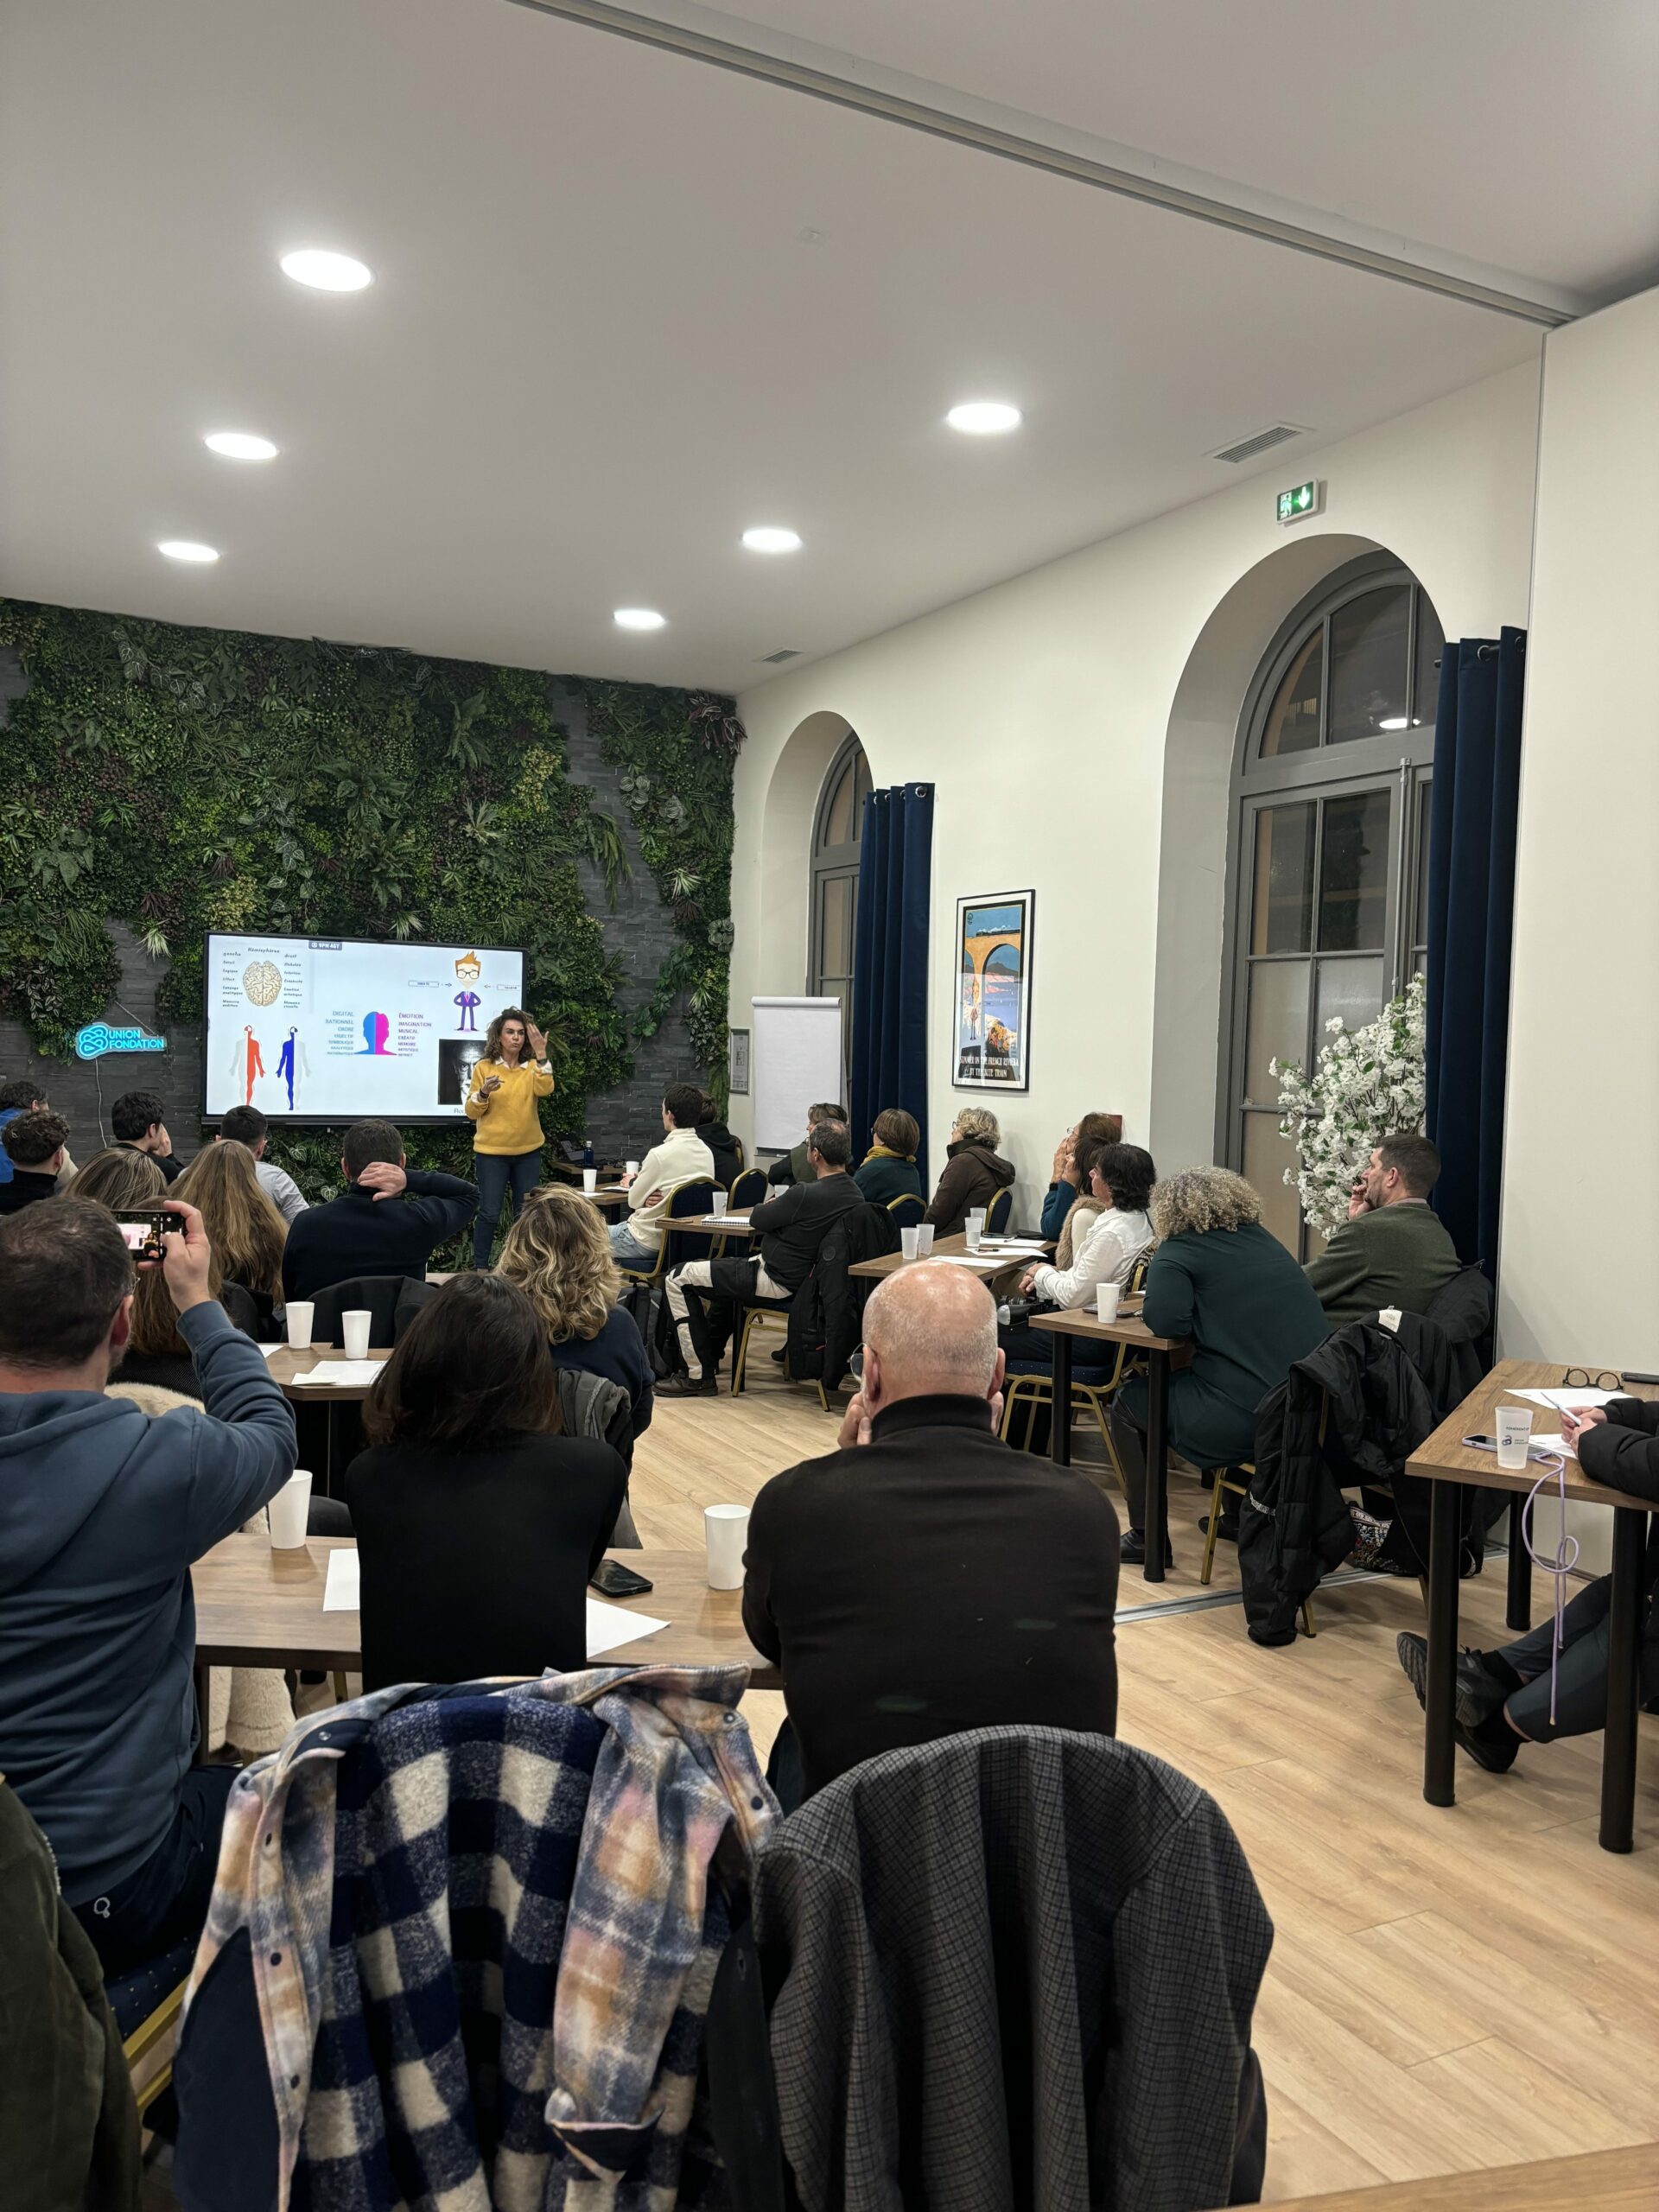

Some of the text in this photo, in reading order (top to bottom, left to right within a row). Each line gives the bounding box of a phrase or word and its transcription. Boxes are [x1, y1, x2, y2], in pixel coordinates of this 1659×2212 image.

[109, 1030, 141, 1039] UNION
[109, 1039, 164, 1049] FONDATION
[995, 1069, 1007, 1077] TRAIN
